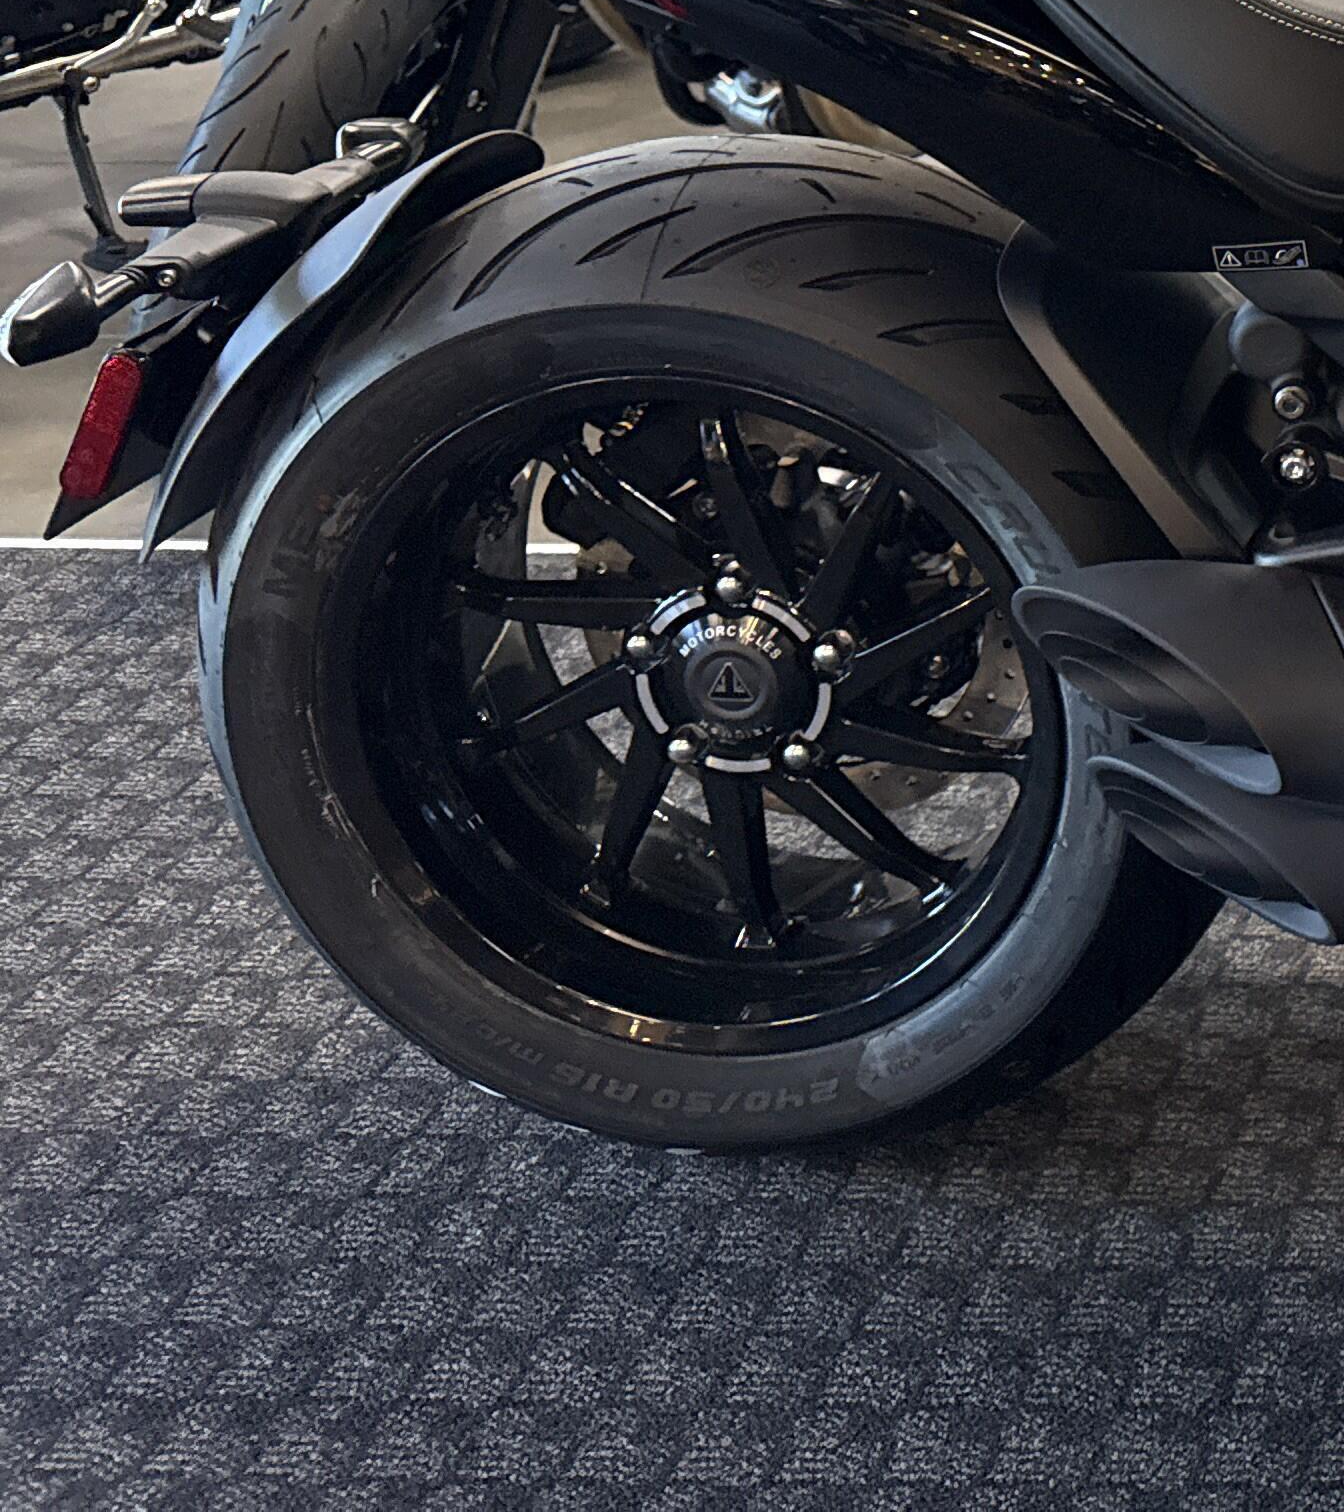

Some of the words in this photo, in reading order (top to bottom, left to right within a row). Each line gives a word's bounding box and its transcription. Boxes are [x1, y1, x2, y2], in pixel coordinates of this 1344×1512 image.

[677, 623, 784, 660] MOTORCYCLES
[547, 1060, 640, 1104] R16
[650, 1074, 840, 1118] 240/50
